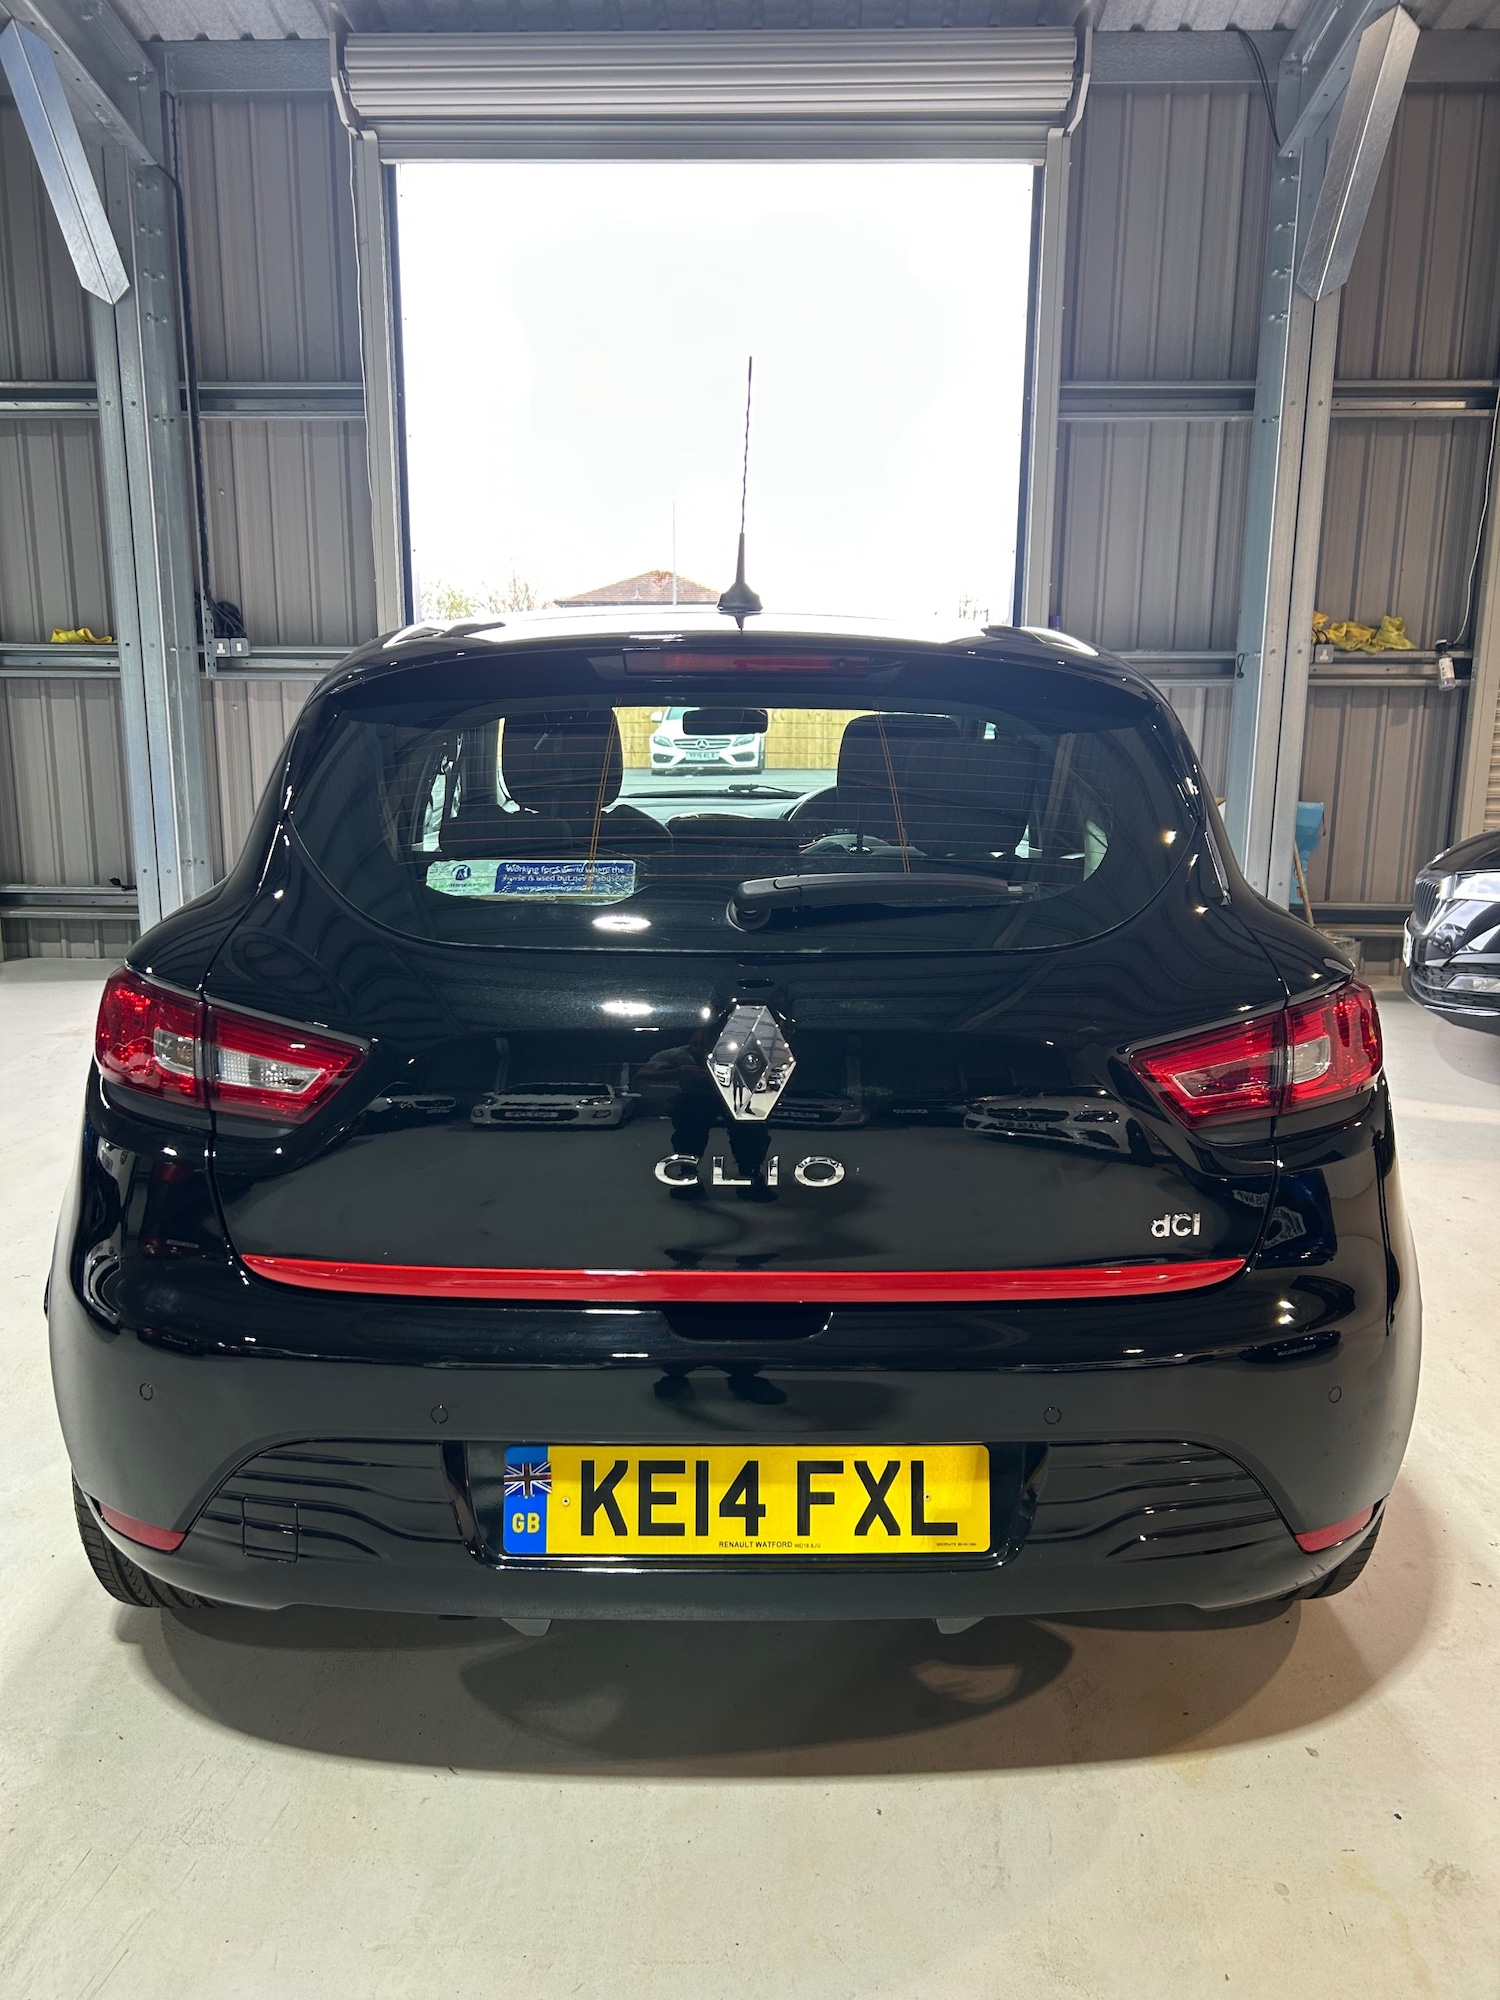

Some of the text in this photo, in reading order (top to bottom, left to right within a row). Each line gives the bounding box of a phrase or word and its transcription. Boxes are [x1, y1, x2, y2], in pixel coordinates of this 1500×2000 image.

[505, 864, 539, 875] Working
[540, 866, 551, 875] for
[611, 866, 625, 874] the
[528, 874, 535, 882] is
[536, 874, 556, 882] used
[557, 874, 573, 882] but
[654, 1153, 845, 1187] CLIO
[580, 1459, 959, 1537] KE14 FXL
[511, 1512, 541, 1534] GB
[718, 1540, 754, 1548] RENAULT
[755, 1540, 793, 1548] WATFORD
